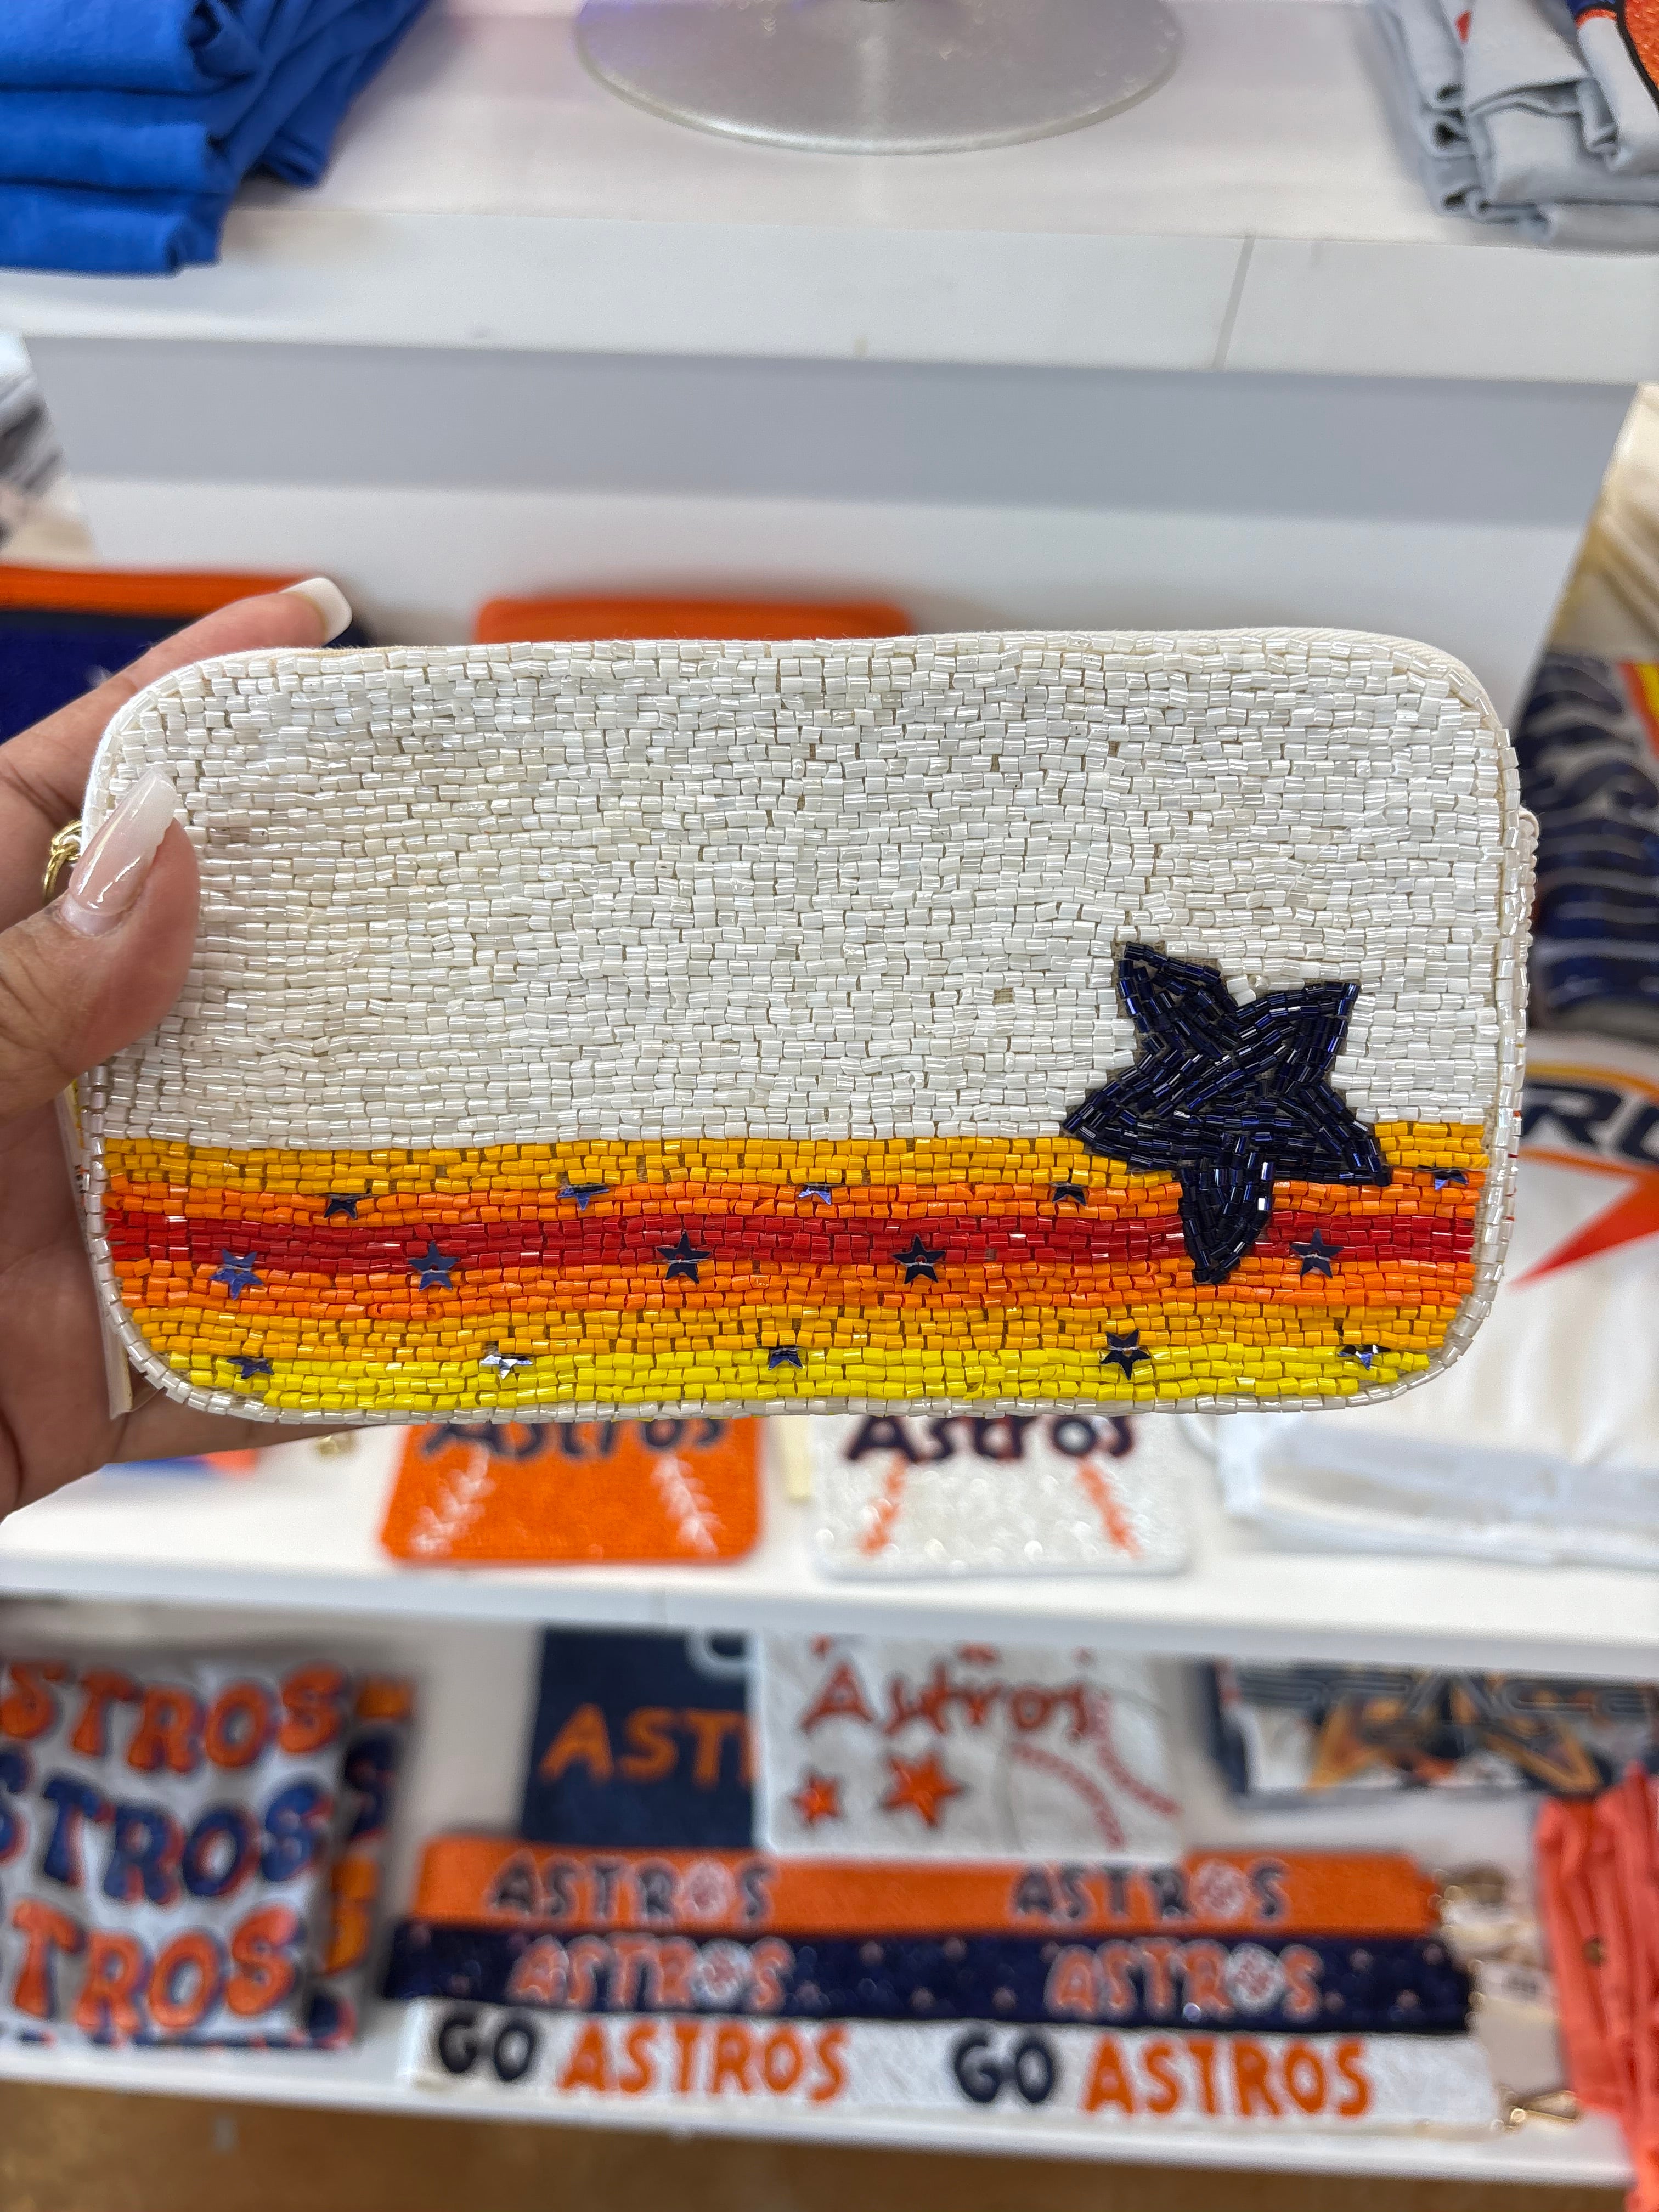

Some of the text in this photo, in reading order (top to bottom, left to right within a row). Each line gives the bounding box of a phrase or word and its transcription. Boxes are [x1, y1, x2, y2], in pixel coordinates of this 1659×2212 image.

[440, 2011, 1373, 2118] GO ASTROS GO ASTROS
